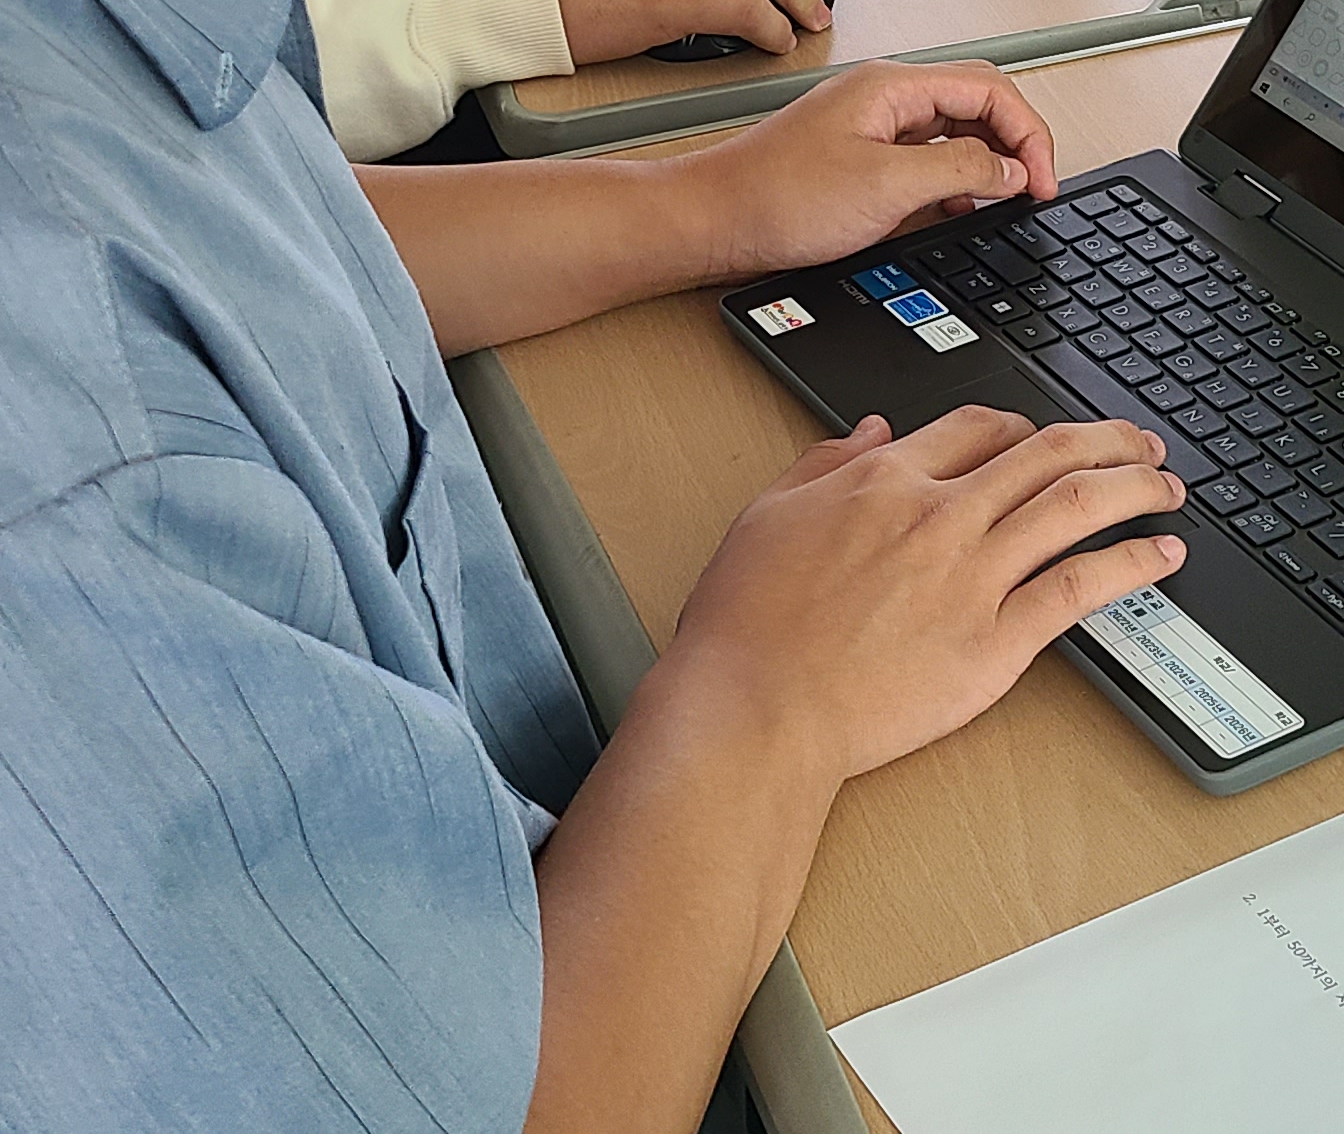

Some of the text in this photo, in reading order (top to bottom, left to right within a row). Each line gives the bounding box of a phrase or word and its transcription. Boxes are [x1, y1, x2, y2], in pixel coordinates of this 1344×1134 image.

[1084, 239, 1101, 250] Q
[1142, 242, 1157, 251] 2
[1053, 259, 1069, 269] A
[1112, 260, 1134, 273] W
[1173, 264, 1187, 274] 3
[1028, 284, 1048, 295] Z
[1083, 282, 1100, 292] S
[1144, 287, 1161, 296] E
[1059, 308, 1077, 318] X
[1112, 306, 1129, 315] D
[1175, 309, 1191, 320] R
[1235, 312, 1252, 321] 5
[1089, 333, 1107, 344] C
[1143, 331, 1161, 342] F
[1208, 335, 1225, 344] T
[1268, 337, 1283, 347] 6
[1121, 357, 1138, 367] V
[1175, 356, 1193, 366] G
[1240, 359, 1258, 369] Y
[1300, 362, 1319, 372] 7
[1151, 384, 1168, 395] B
[1206, 381, 1227, 393] H
[1273, 385, 1292, 397] U
[1183, 410, 1204, 422] N
[1241, 411, 1259, 419] J
[1309, 414, 1324, 422] I
[1214, 436, 1236, 452] M
[1274, 434, 1295, 447] K
[1310, 464, 1327, 476] L
[1107, 608, 1138, 633] 2022년
[1135, 634, 1167, 659] 2023년
[1165, 660, 1196, 685] 2024년
[1194, 687, 1226, 713] 2025년
[1224, 715, 1256, 742] 2026년
[1242, 892, 1256, 906] 2.
[1257, 908, 1291, 939] 1부터
[1287, 940, 1338, 992] 50까지의
